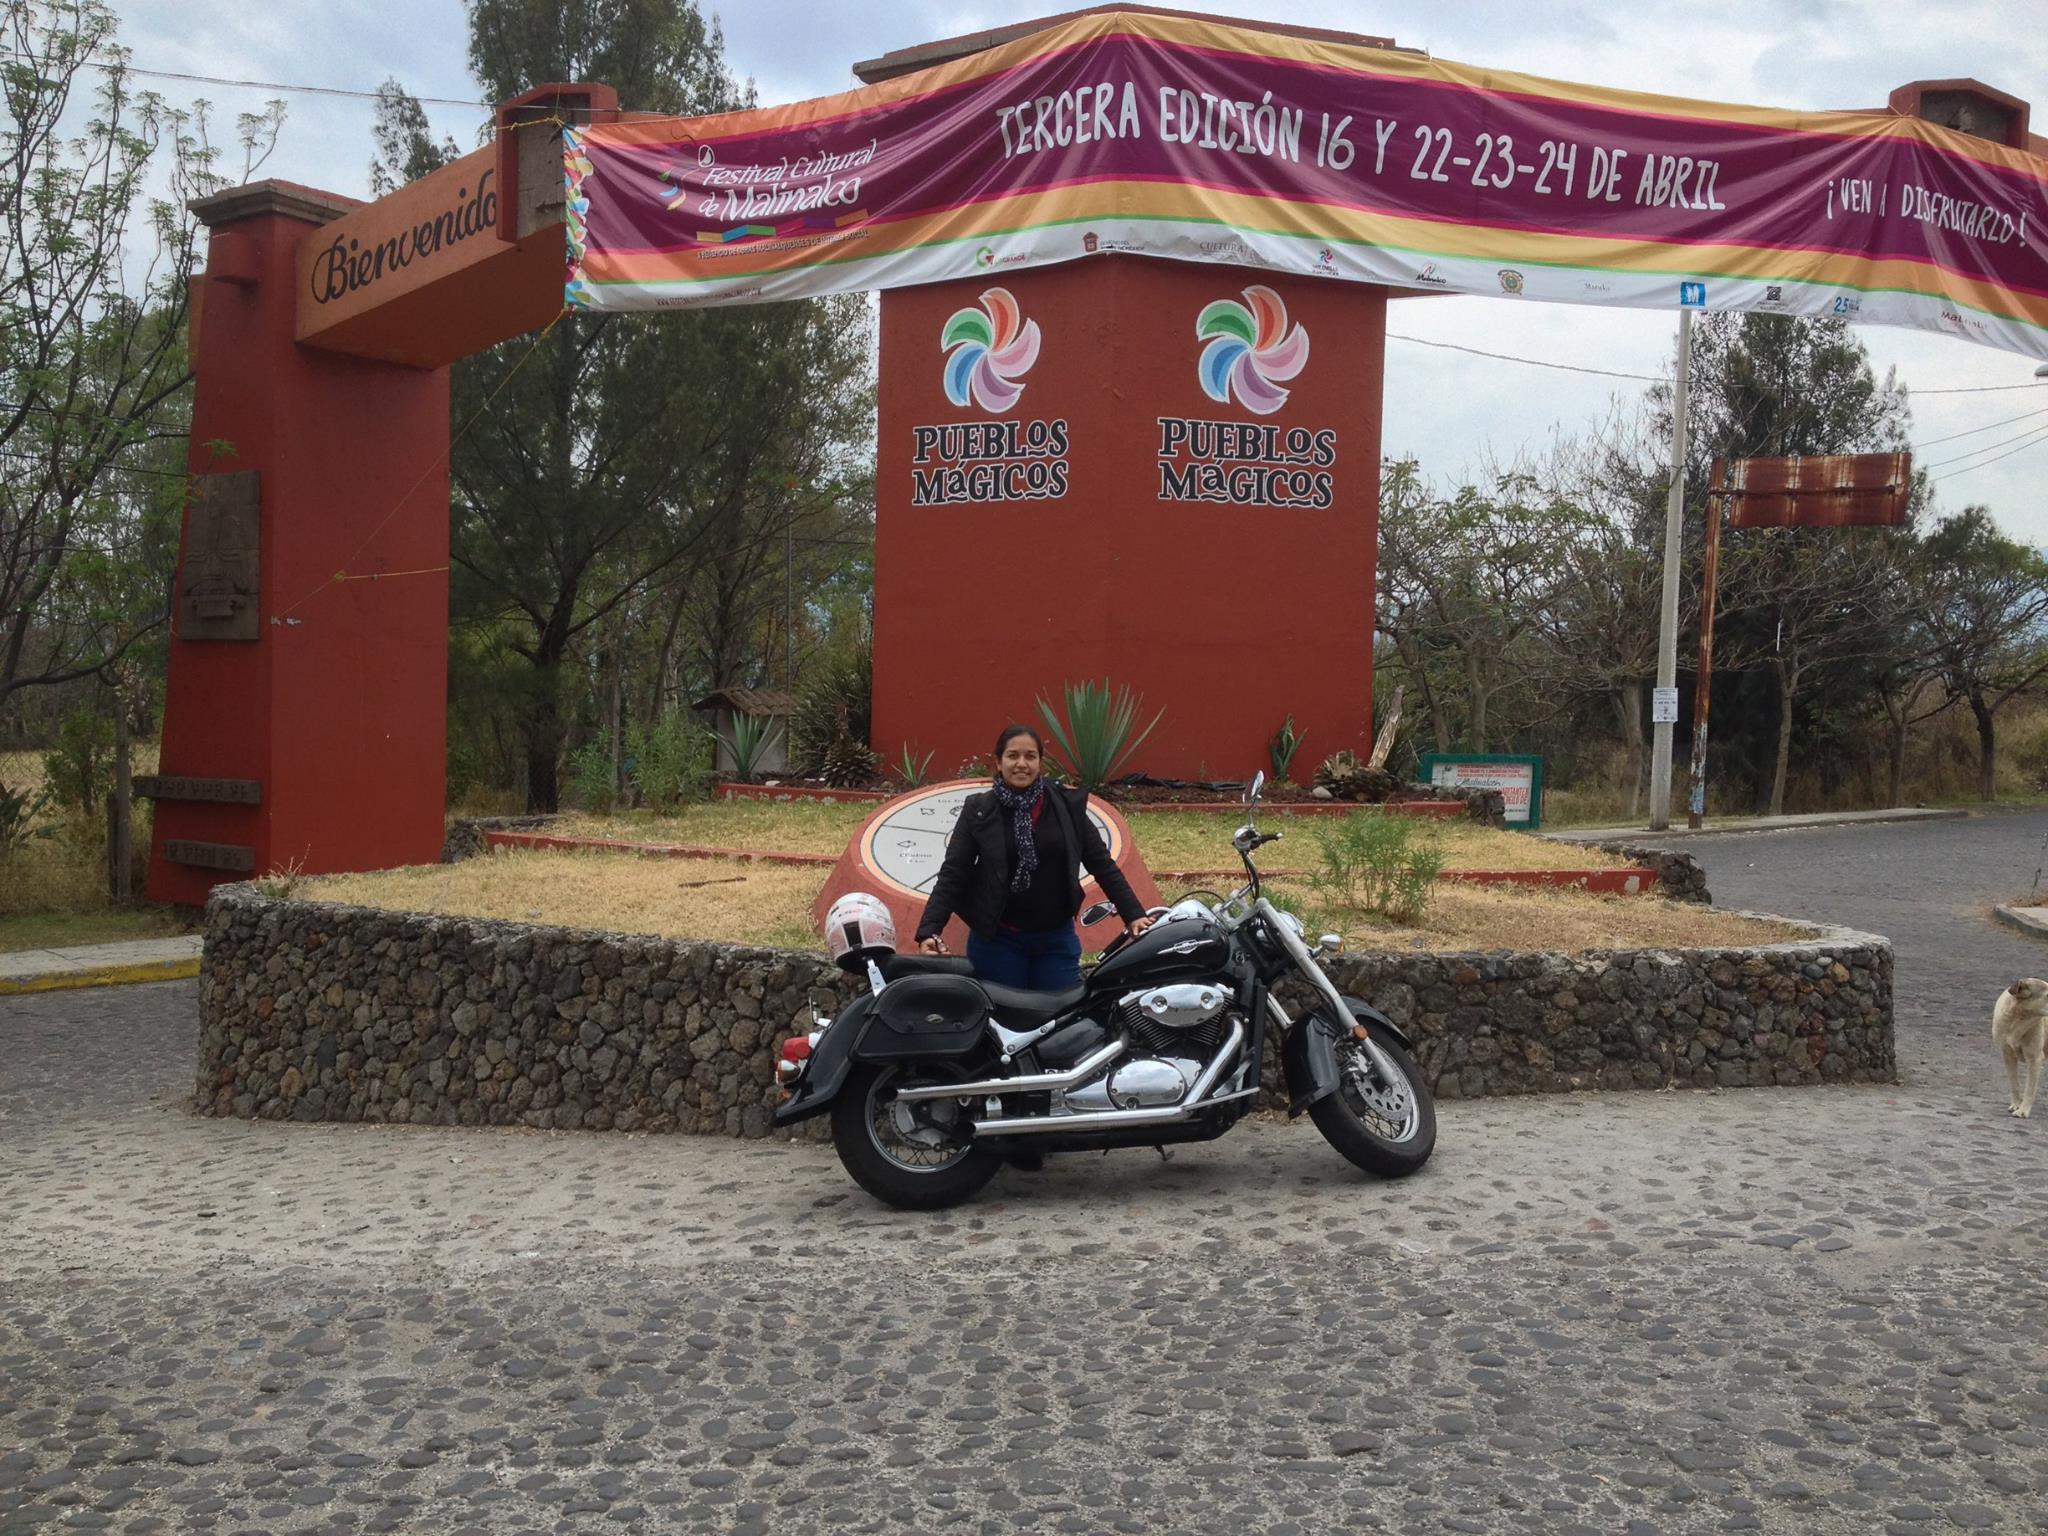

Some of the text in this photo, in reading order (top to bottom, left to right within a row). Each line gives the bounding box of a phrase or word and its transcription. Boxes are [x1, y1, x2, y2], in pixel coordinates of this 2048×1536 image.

[703, 138, 877, 186] Festival Cultural
[996, 81, 1726, 211] TERCERA EDICIÓN 16 Y 22-23-24 DE ABRIL
[698, 174, 862, 222] de Malinalco
[912, 418, 1069, 463] PUEBLOS
[1157, 416, 1337, 467] PUEBLOS
